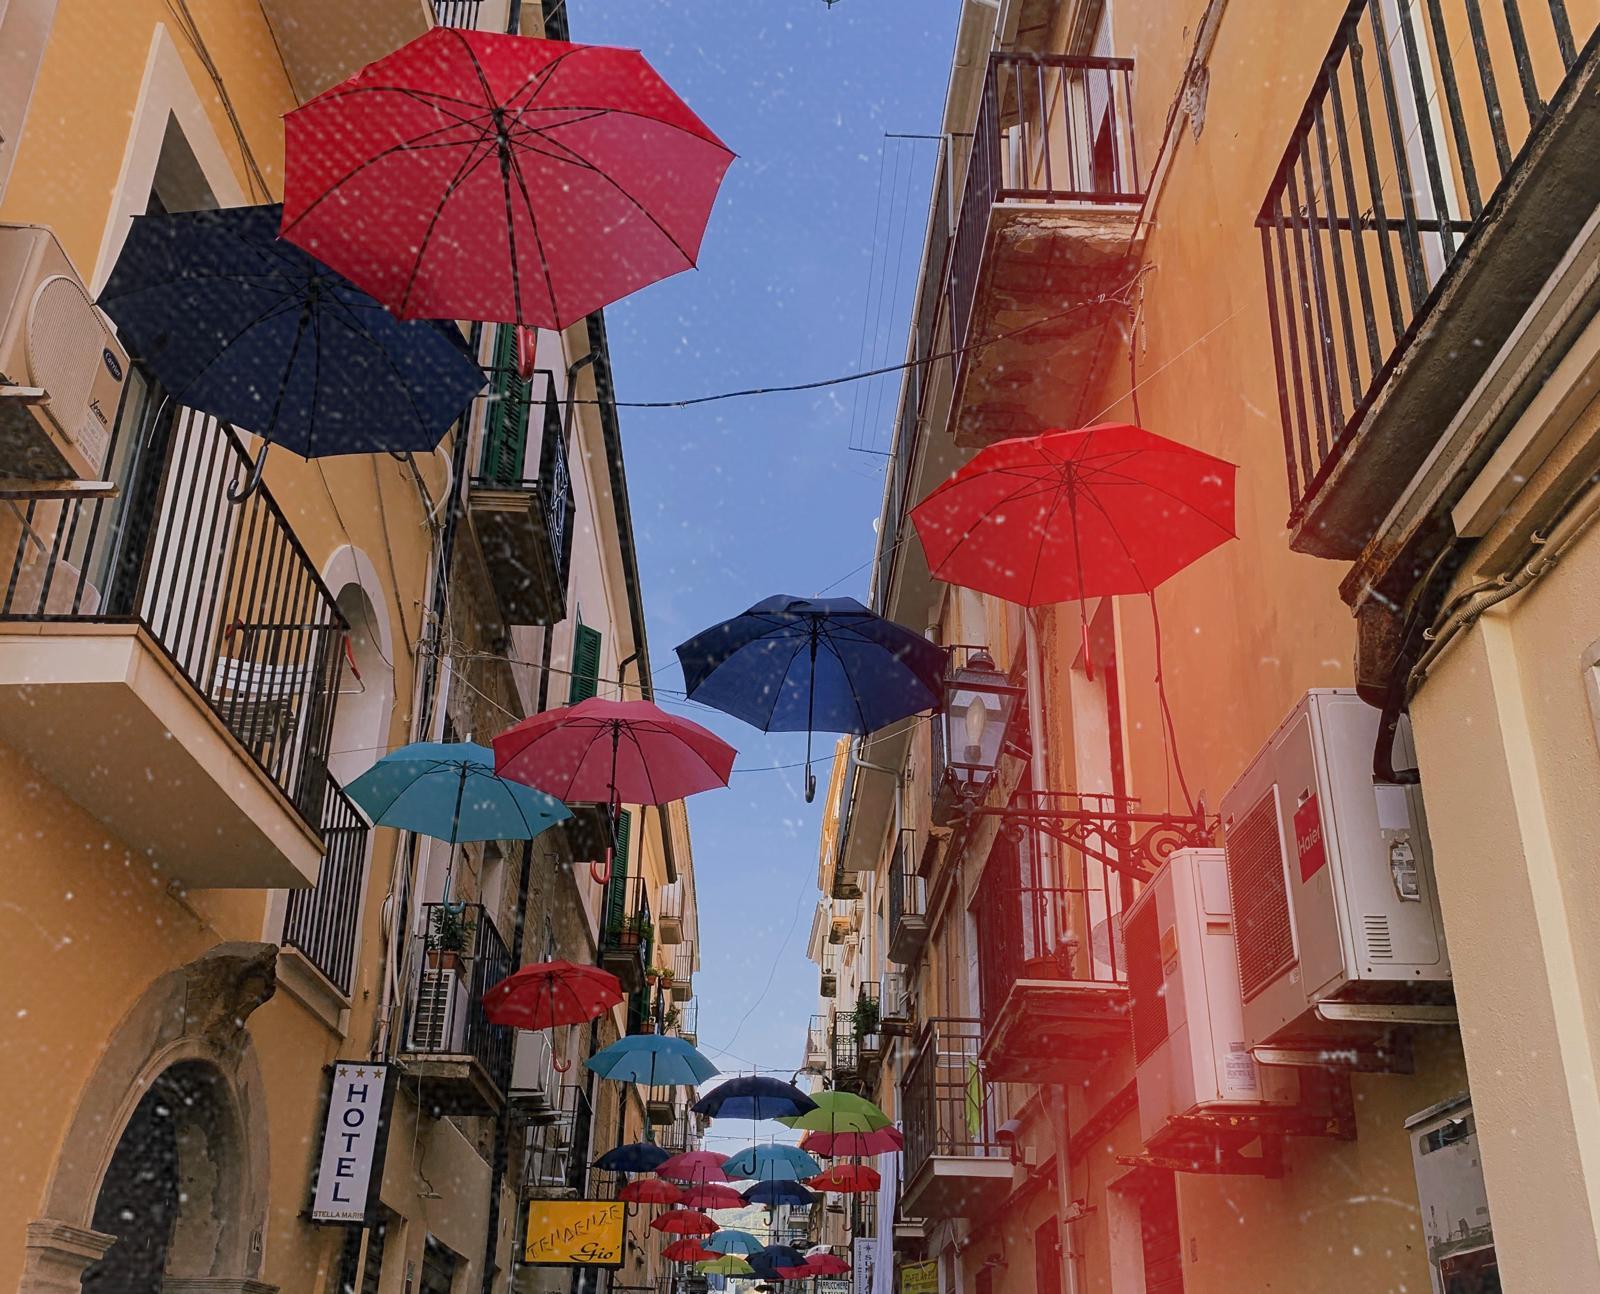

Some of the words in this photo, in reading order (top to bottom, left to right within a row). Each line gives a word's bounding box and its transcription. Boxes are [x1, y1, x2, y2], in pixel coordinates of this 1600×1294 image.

[105, 352, 120, 377] Carrier
[1298, 824, 1320, 858] Haier
[331, 1083, 369, 1203] HOTEL
[341, 1211, 364, 1220] MARIS
